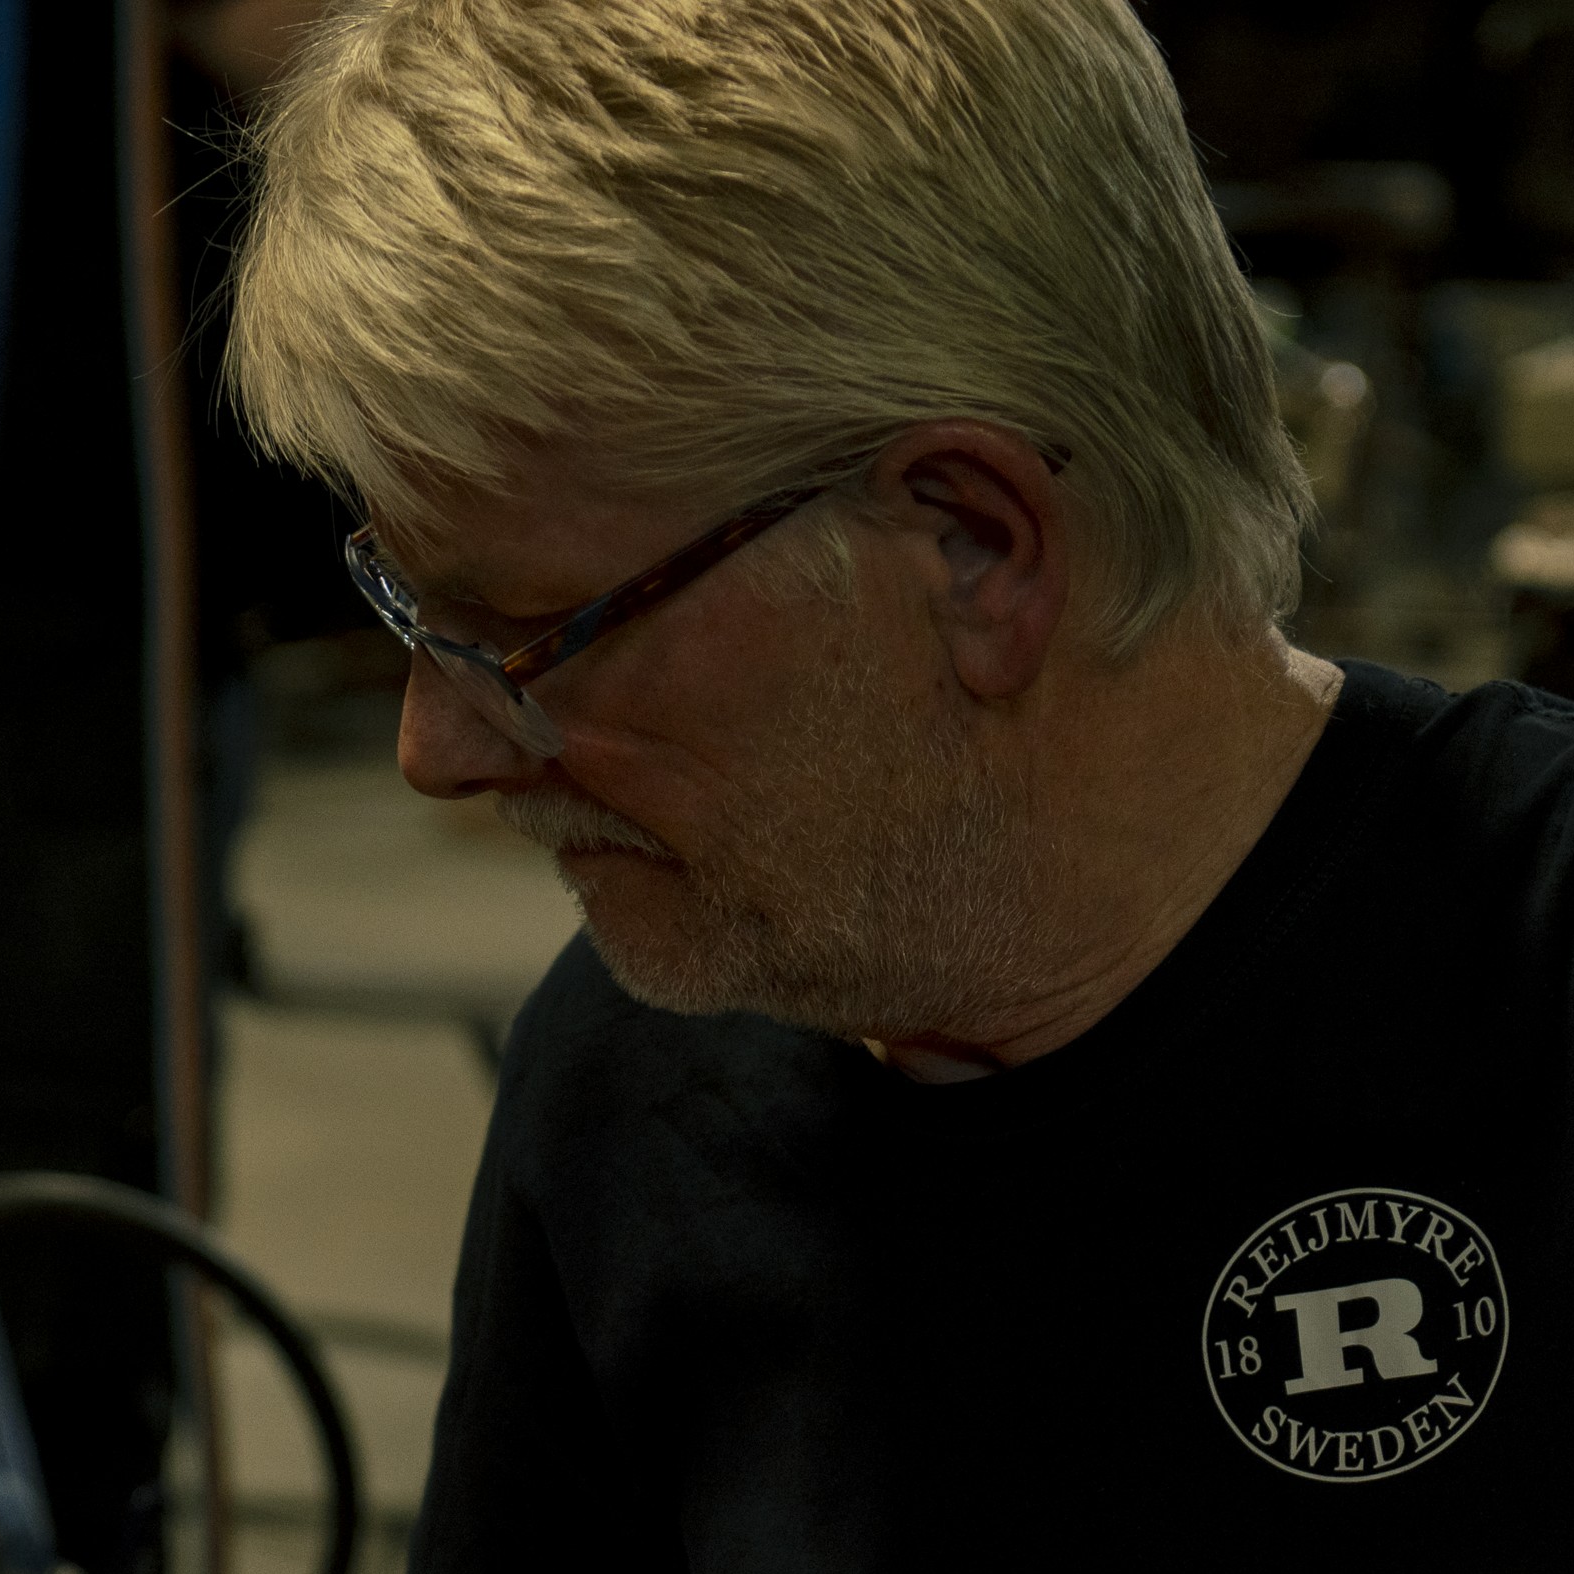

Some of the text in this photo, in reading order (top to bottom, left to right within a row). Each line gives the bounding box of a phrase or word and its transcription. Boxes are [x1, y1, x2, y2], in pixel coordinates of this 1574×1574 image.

[1223, 1199, 1486, 1319] REIJMYRE
[1214, 1296, 1497, 1379] 18 10
[1274, 1277, 1439, 1396] R
[1251, 1371, 1475, 1471] SWEDEN
